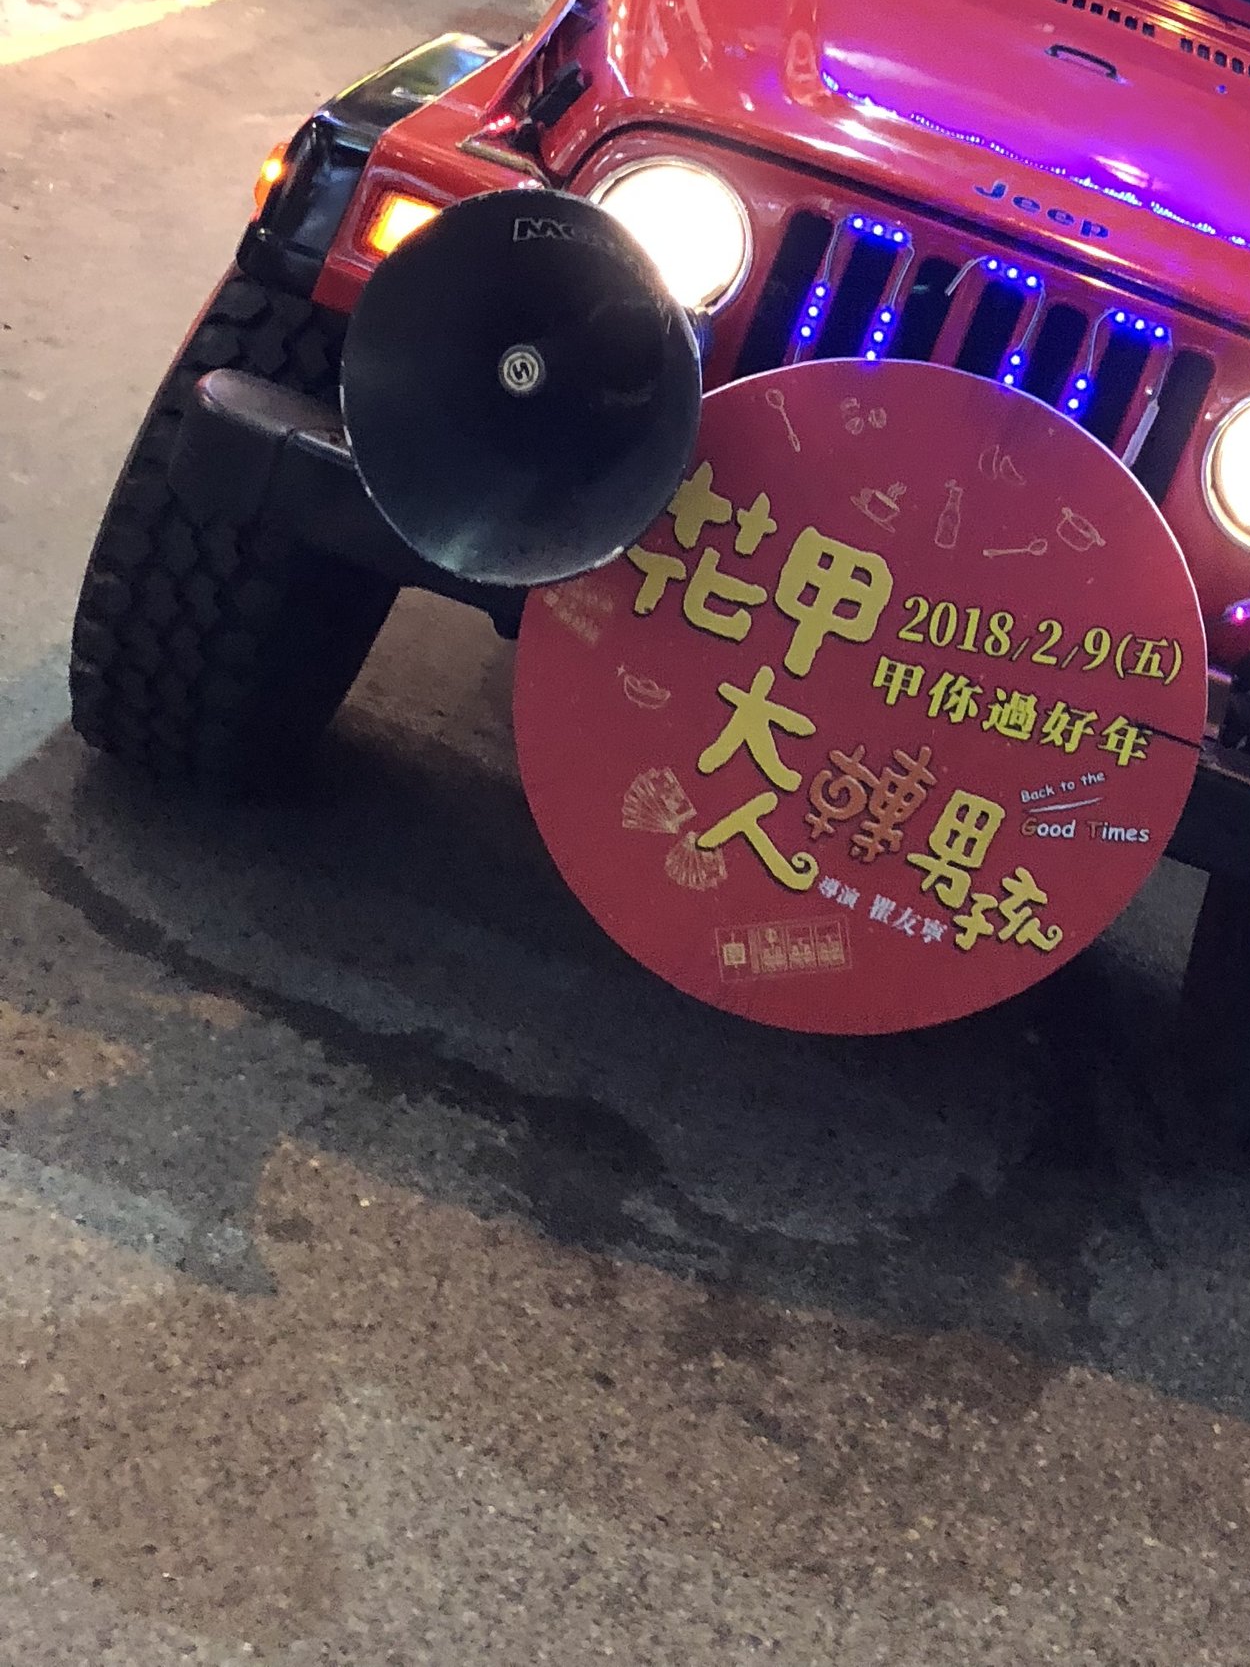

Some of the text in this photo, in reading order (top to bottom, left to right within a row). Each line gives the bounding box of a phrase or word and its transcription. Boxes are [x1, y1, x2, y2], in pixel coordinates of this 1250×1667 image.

[973, 180, 1110, 239] Jeep
[872, 657, 1153, 767] 甲你過好年
[1020, 771, 1106, 803] Back to the
[1020, 817, 1150, 843] Good Times
